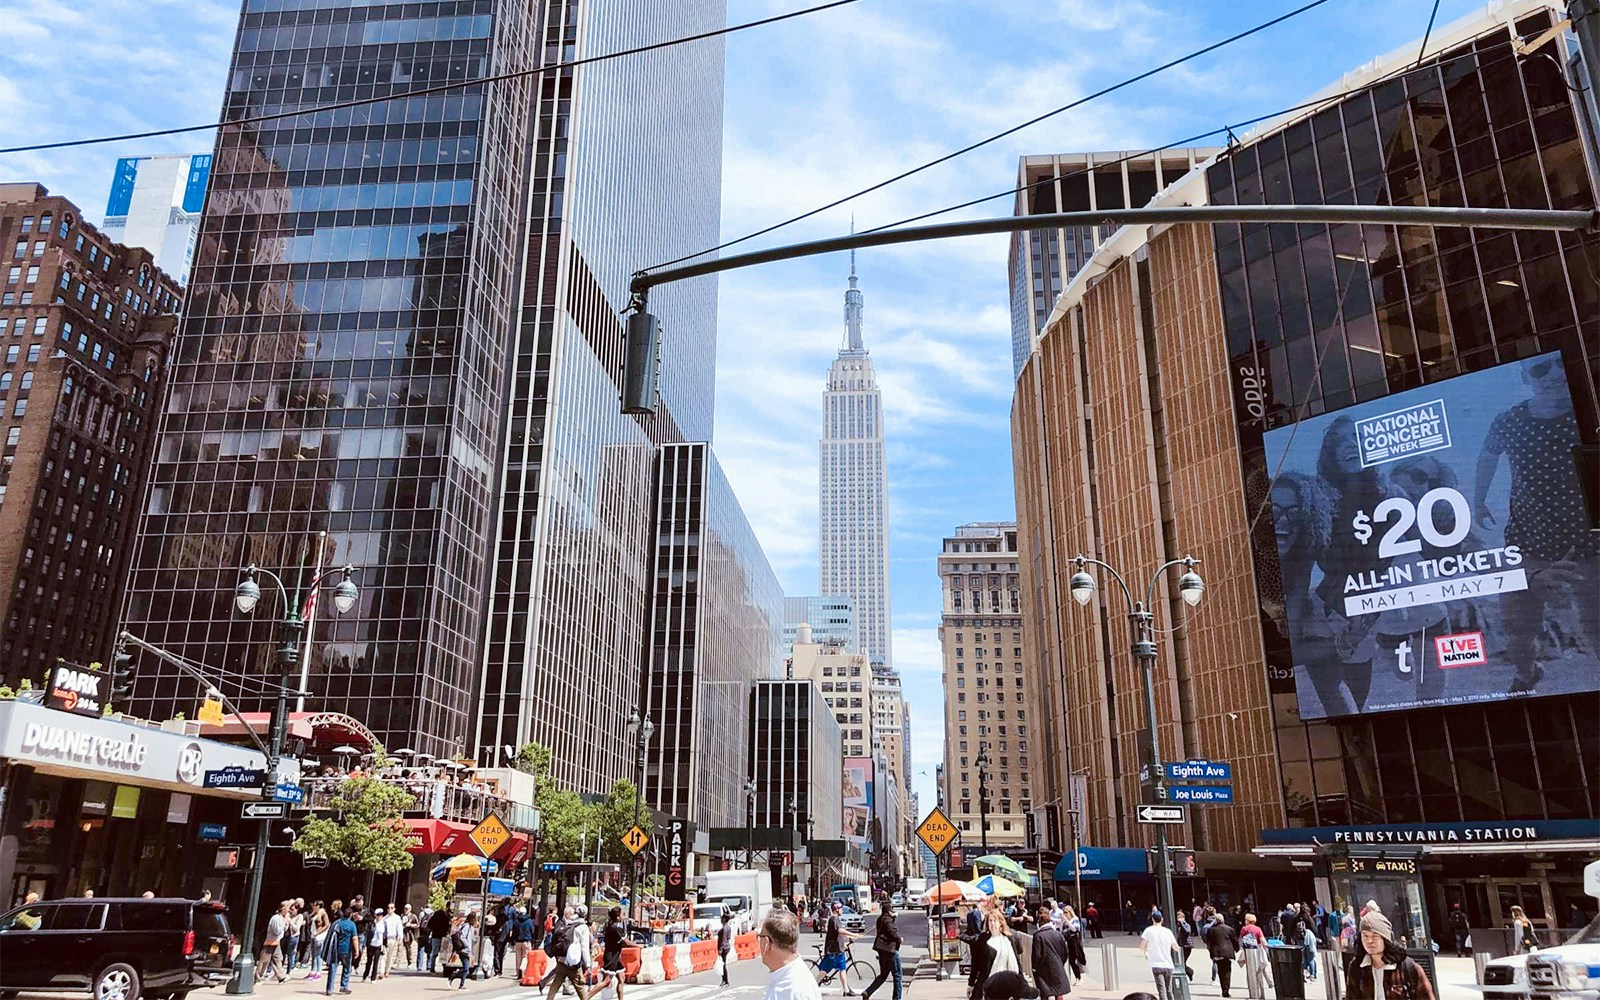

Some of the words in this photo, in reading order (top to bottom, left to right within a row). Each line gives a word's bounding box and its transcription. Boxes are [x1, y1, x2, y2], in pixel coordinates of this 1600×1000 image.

[1363, 406, 1439, 437] NATIONAL
[1364, 420, 1441, 451] CONCERT
[1389, 440, 1419, 455] WEEK
[1352, 486, 1471, 559] $20
[1343, 563, 1413, 594] ALL-IN
[1416, 545, 1523, 580] TICKETS
[1362, 593, 1398, 611] MAY
[1409, 591, 1415, 602] 1
[1441, 580, 1482, 598] MAY
[1494, 576, 1504, 589] 7
[1441, 639, 1477, 654] LIVE
[1394, 640, 1412, 673] t
[1444, 651, 1480, 662] NATION
[55, 667, 101, 696] PARK
[180, 749, 201, 778] DR
[209, 773, 236, 785] Eighth
[238, 774, 255, 783] Ave
[1172, 765, 1204, 778] Eighth
[1206, 766, 1225, 776] Ave
[276, 788, 288, 798] West
[296, 791, 302, 800] St
[1175, 789, 1189, 800] Joe
[1191, 789, 1213, 800] Louis
[480, 826, 502, 835] DEAD
[926, 823, 948, 831] DEAD
[482, 836, 498, 845] END
[1334, 830, 1458, 843] PENNSYLVANIA
[1465, 827, 1536, 841] STATION
[671, 822, 682, 867] PARK
[1078, 853, 1088, 868] D
[1385, 862, 1408, 871] TAXI
